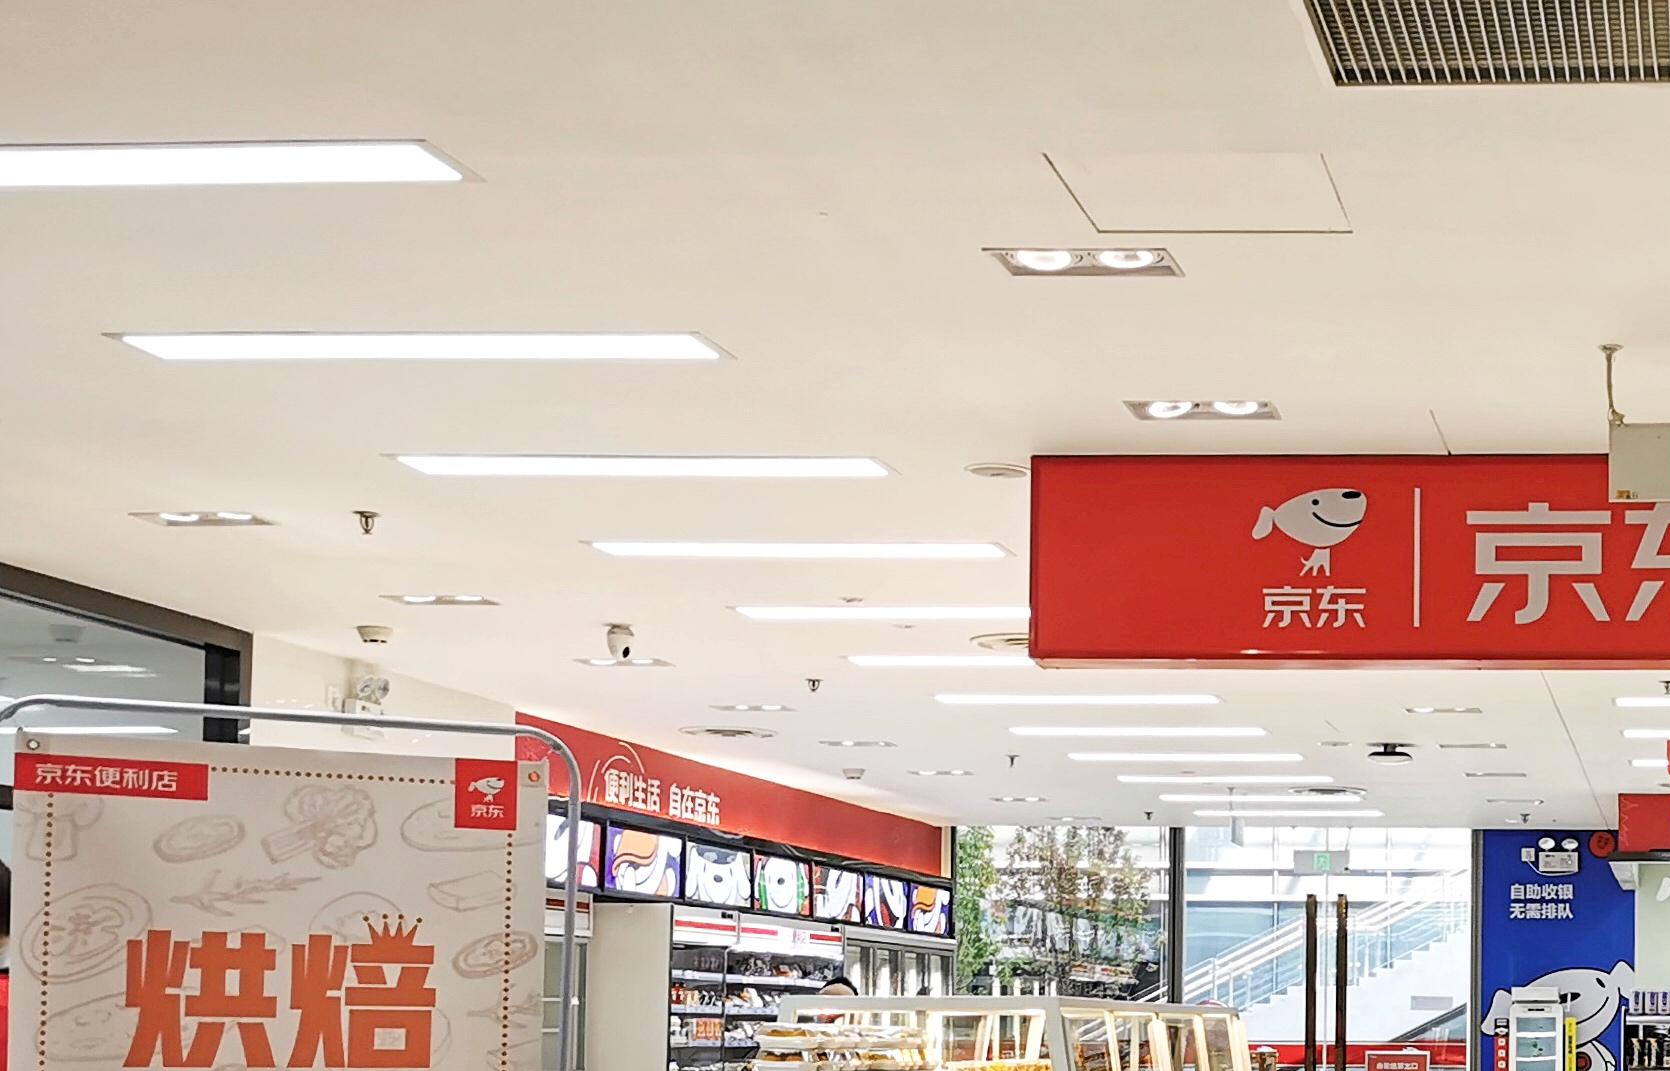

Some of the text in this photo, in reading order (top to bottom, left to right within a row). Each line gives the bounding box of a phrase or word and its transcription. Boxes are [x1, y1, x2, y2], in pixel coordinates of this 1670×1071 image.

[1263, 586, 1366, 627] 京东
[35, 763, 178, 792] 京东便利店
[604, 768, 721, 825] 便利生活 自在京东
[471, 805, 504, 818] 京东
[1511, 884, 1573, 899] 自助收银
[1510, 903, 1573, 919] 无需排队
[122, 925, 436, 1068] 烘焙
